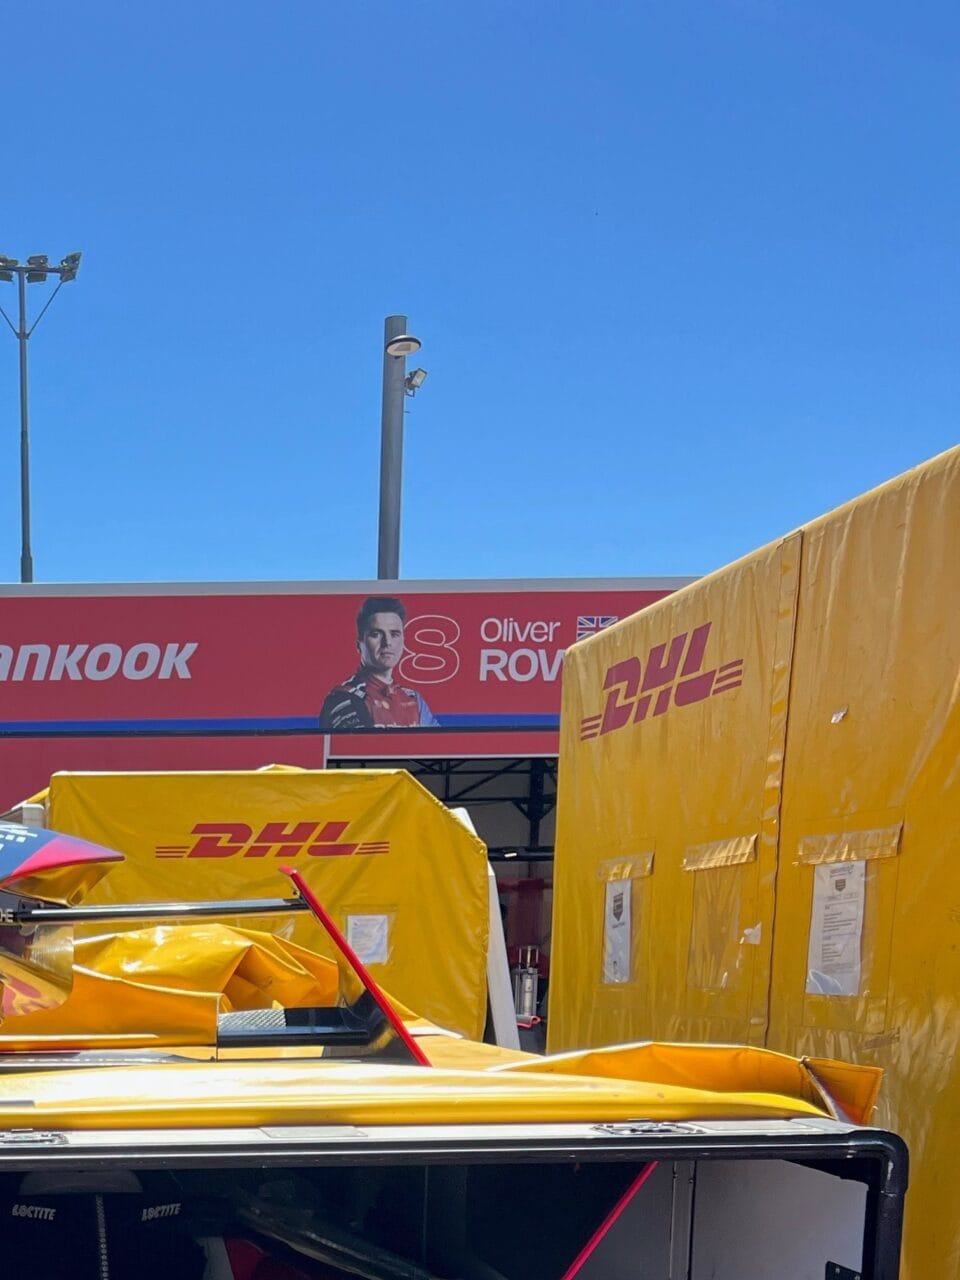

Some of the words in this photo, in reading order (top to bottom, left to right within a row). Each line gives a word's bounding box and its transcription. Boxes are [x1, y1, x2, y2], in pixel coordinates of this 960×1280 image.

[480, 617, 561, 642] Oliver
[599, 621, 717, 736] DHL
[187, 821, 359, 858] DHL
[11, 1204, 57, 1220] LOCTITE
[140, 1203, 182, 1221] LOCTITE
